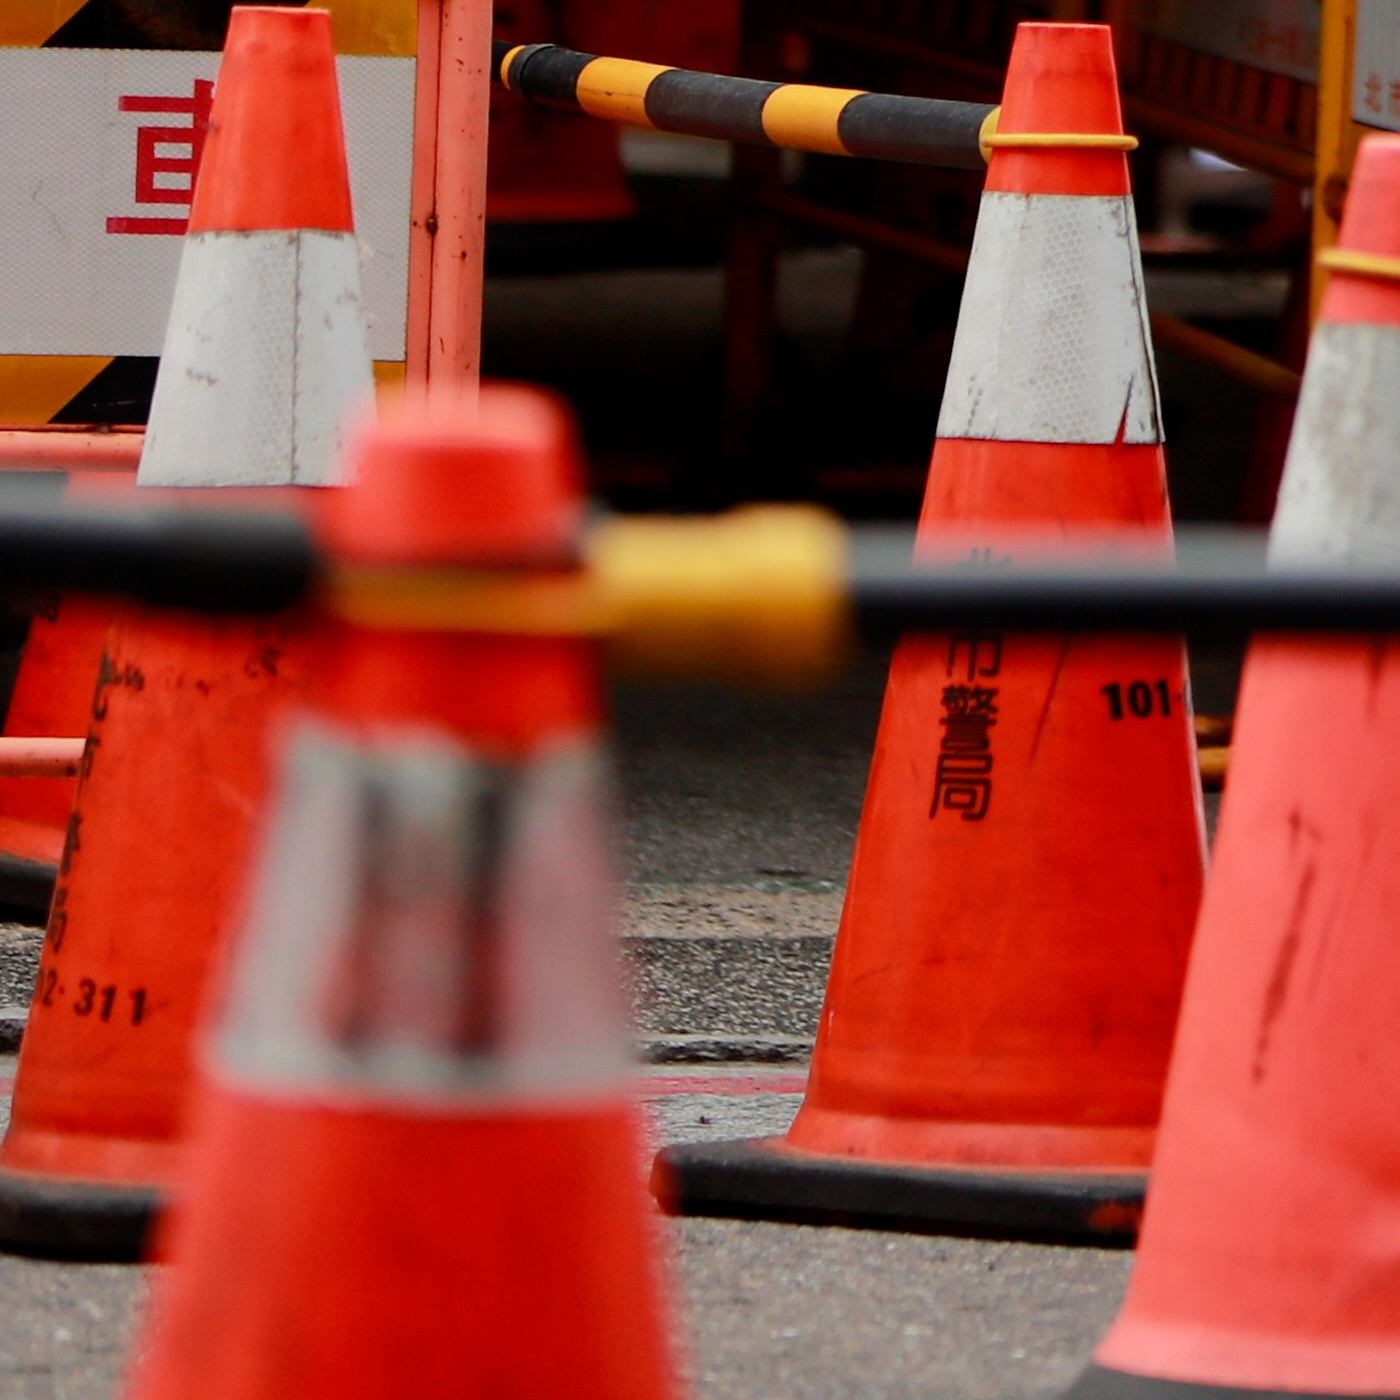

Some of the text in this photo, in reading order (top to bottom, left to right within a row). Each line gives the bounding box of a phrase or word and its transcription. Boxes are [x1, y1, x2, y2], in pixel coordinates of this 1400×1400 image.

[930, 548, 1003, 822] 市警局
[38, 968, 147, 1027] 2-311
